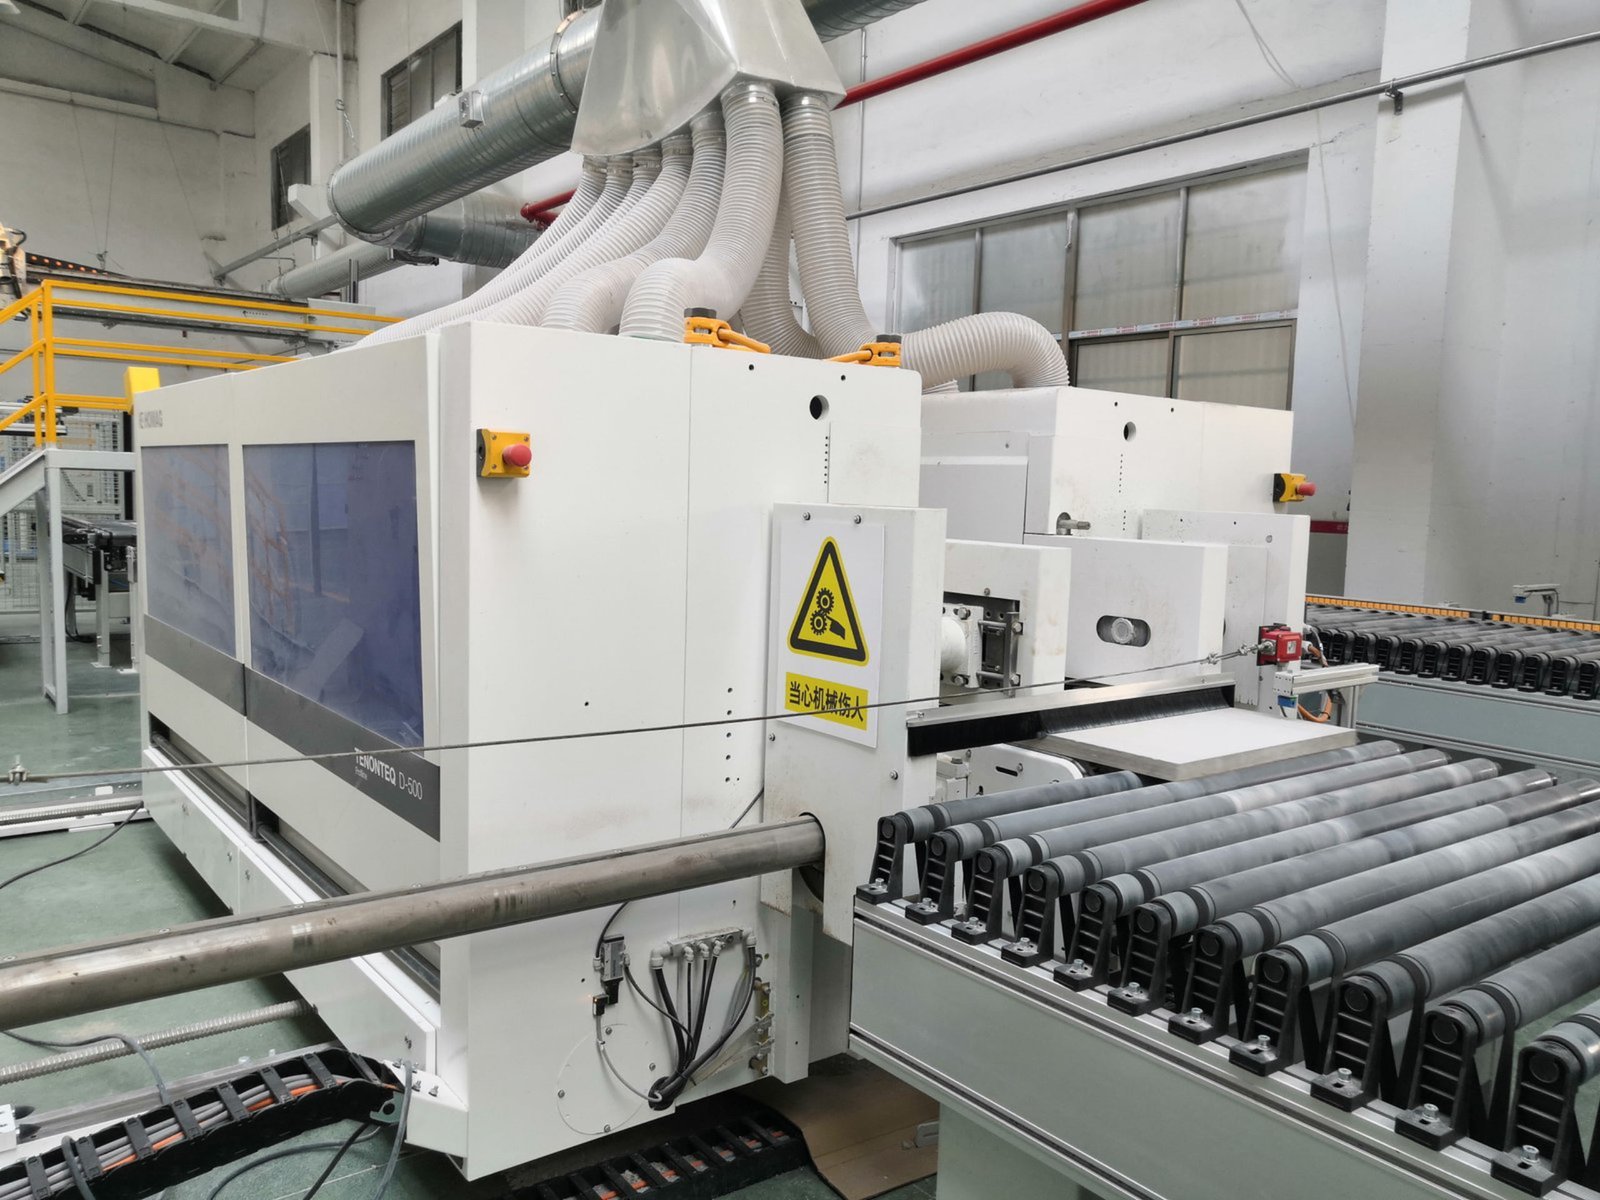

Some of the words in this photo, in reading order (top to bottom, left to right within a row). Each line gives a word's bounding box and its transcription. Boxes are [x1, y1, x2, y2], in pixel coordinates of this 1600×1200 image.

[789, 681, 864, 722] 当心机械伤人
[354, 747, 397, 786] TENONTEQ
[398, 771, 423, 801] D-500
